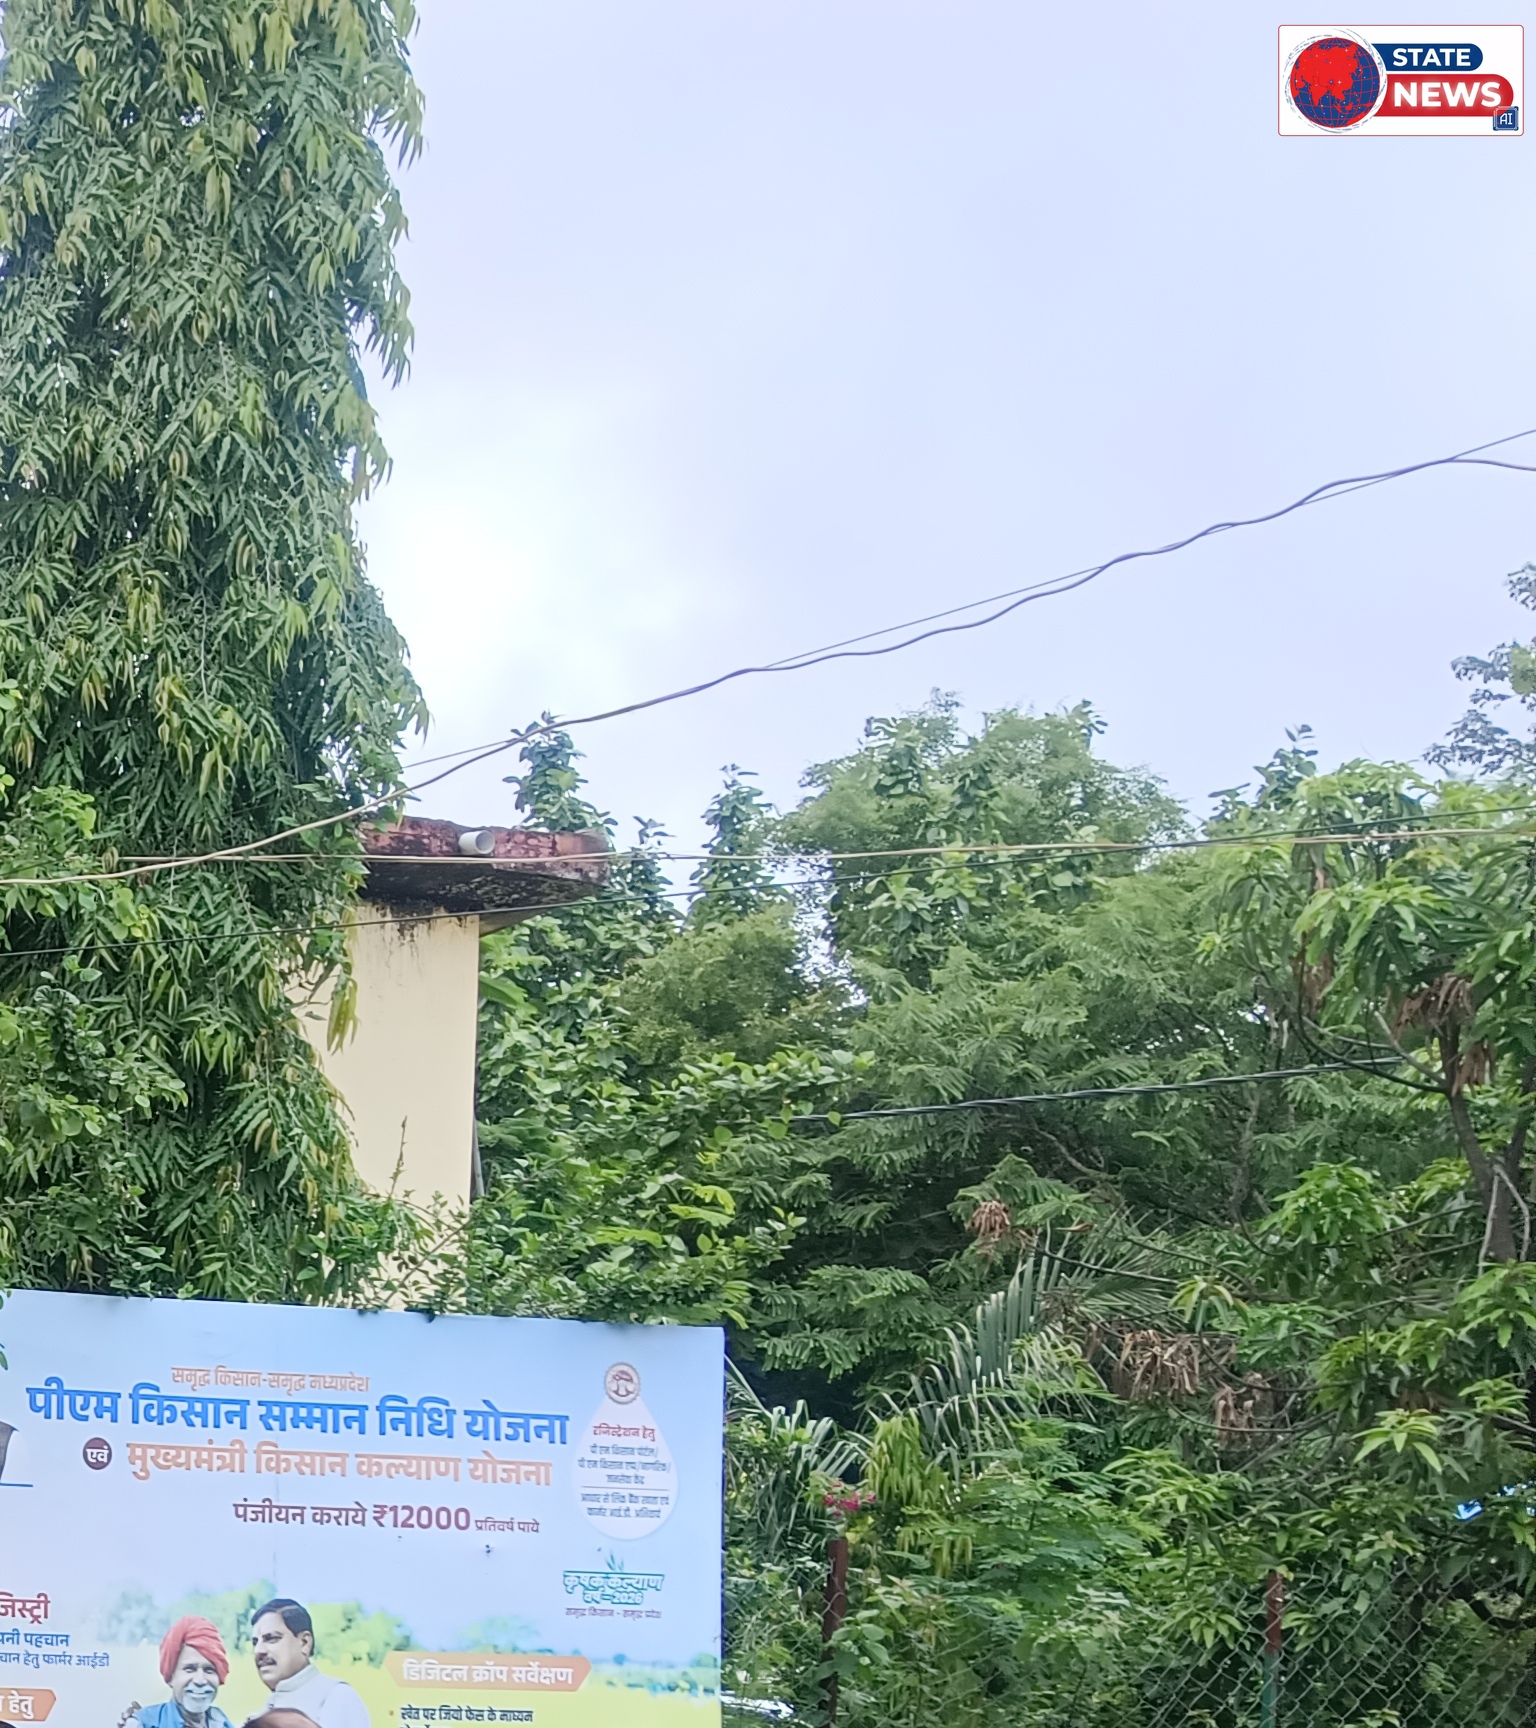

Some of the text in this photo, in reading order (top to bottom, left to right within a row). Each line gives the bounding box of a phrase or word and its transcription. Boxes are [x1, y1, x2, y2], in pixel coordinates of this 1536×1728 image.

[171, 1367, 210, 1391] समृद्ध
[309, 1372, 369, 1392] मध्यप्रदेश
[26, 1376, 569, 1445] पीएम किसान सम्मान निधि योजना
[86, 1445, 109, 1463] एवं
[127, 1438, 552, 1486] मुख्यमंत्री किसान कल्याण योजना
[233, 1497, 305, 1525] पंजीयन
[311, 1501, 367, 1527] कराये
[373, 1504, 470, 1531] ₹12000
[24, 1633, 69, 1648] पहचान
[23, 1650, 40, 1668] हेतु
[43, 1651, 73, 1666] फार्मर
[76, 1653, 109, 1669] आईडी
[402, 1658, 574, 1685] डिजिटल क्रॉप सर्वेक्षण
[8, 1688, 34, 1720] हेतु
[422, 1708, 436, 1720] पर
[487, 1706, 497, 1721] के
